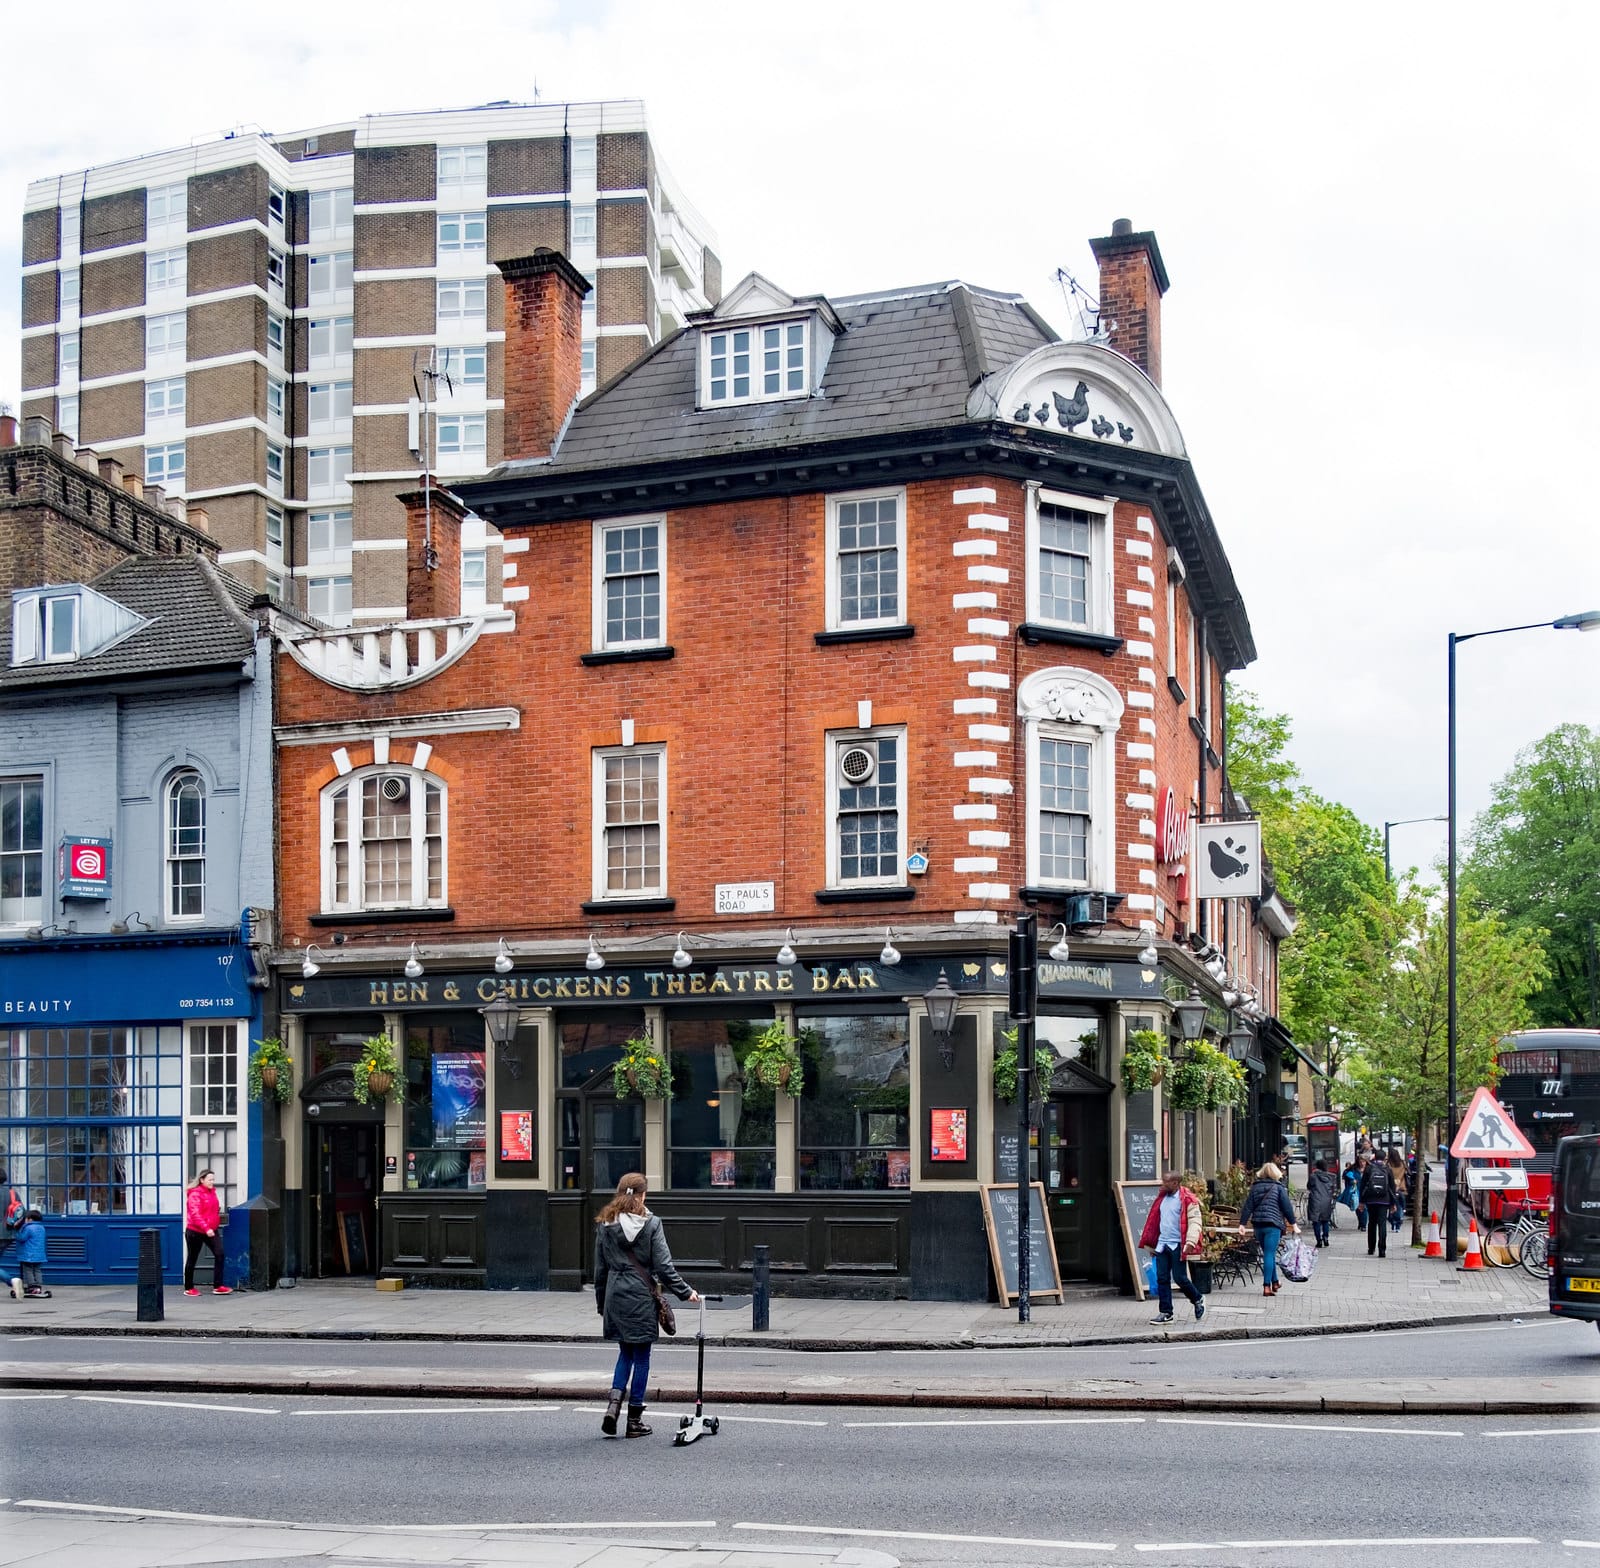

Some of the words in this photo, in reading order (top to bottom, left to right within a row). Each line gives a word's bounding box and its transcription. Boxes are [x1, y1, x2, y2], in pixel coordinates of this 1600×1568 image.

[737, 888, 769, 899] PAUL'S
[719, 900, 746, 911] ROAD
[218, 955, 234, 966] 107
[1037, 963, 1113, 991] CHARRINGTON
[369, 980, 430, 1005] HEN
[443, 980, 461, 1002] &
[477, 976, 631, 1002] CHICKENS
[644, 969, 795, 996] THEATRE
[811, 967, 879, 992] BAR
[5, 1000, 72, 1013] BEAUTY
[179, 999, 194, 1008] 020
[195, 998, 214, 1008] 7354
[215, 998, 234, 1007] 1133
[1542, 1080, 1561, 1095] 277
[1542, 1111, 1574, 1119] Stagecoach
